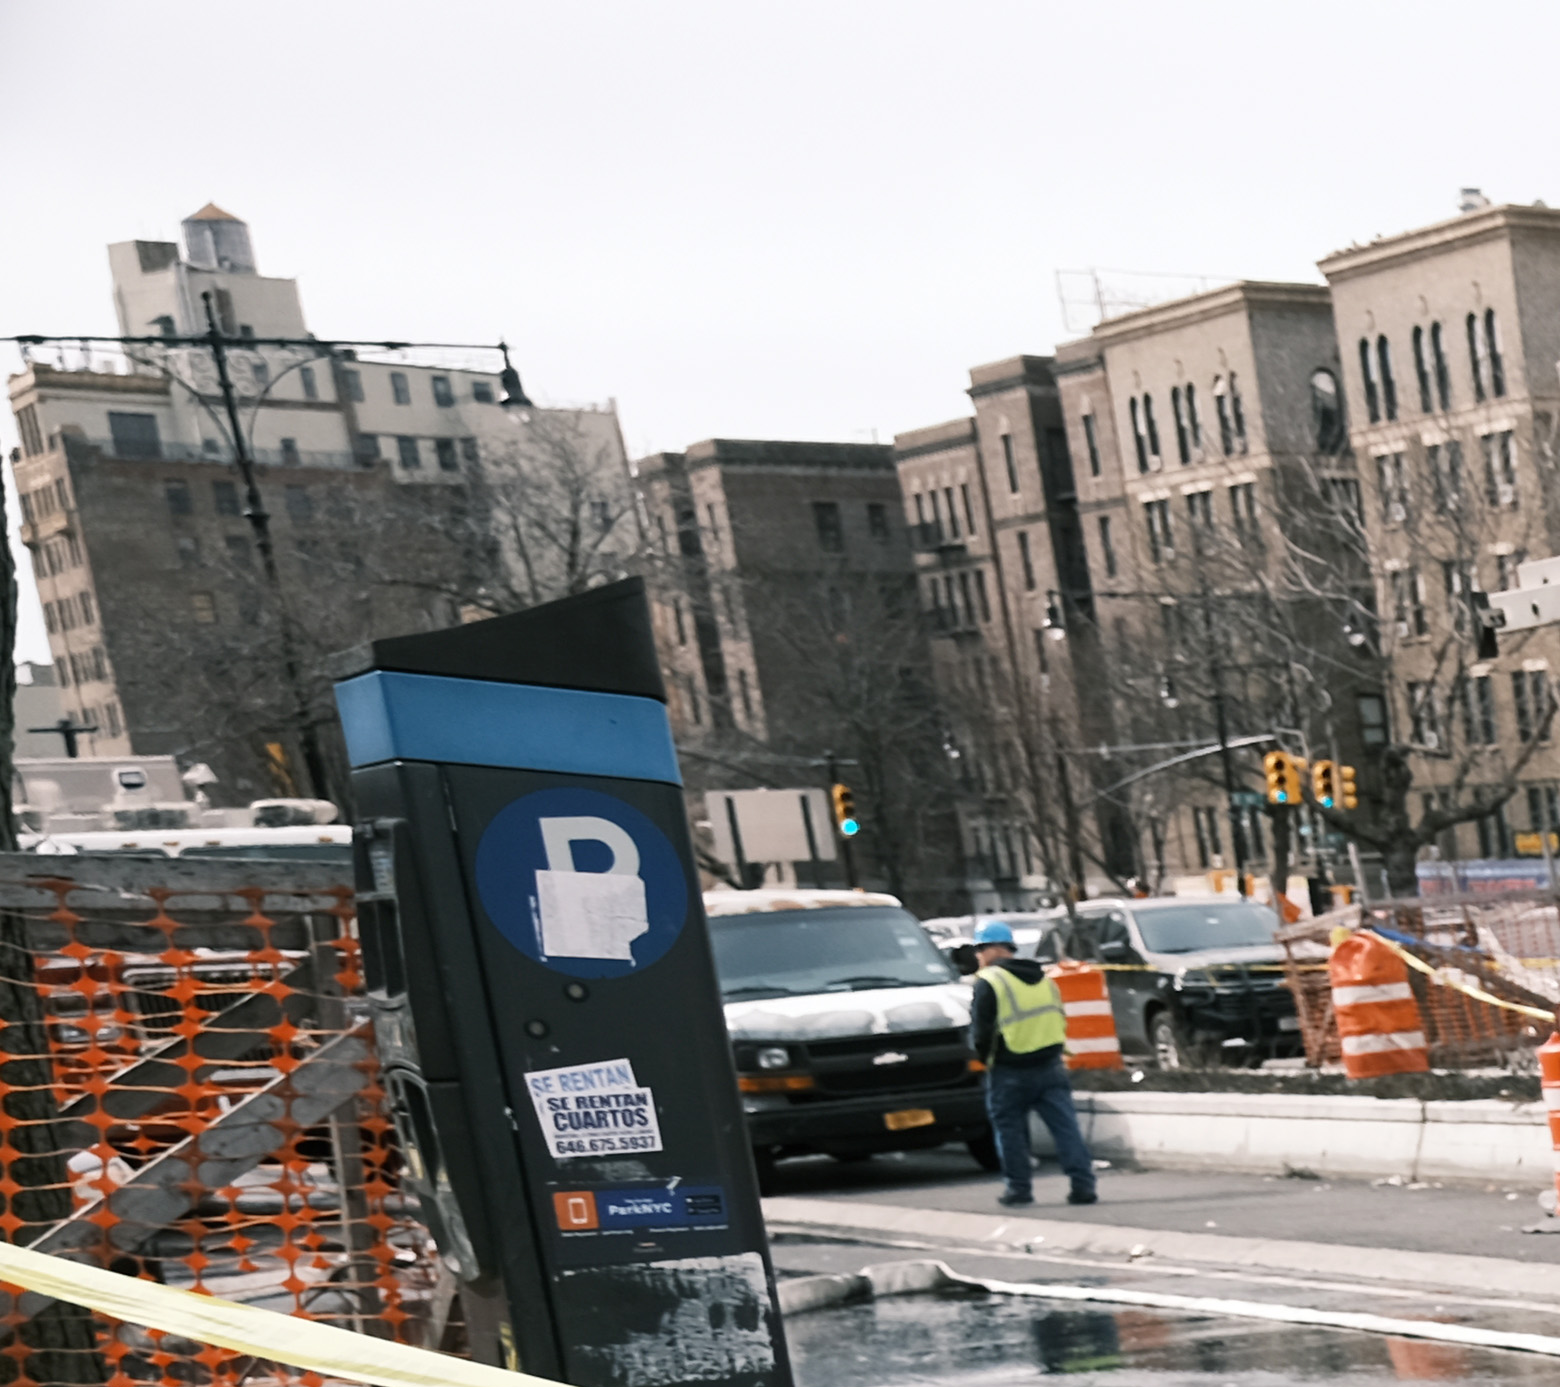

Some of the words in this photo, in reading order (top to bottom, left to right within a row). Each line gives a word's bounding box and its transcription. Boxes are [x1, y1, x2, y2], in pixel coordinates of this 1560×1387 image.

[531, 1075, 553, 1095] SE
[559, 1065, 631, 1092] RENTAN
[547, 1097, 573, 1112] SE
[576, 1093, 648, 1109] RENTAN
[553, 1108, 650, 1132] CUARTOS
